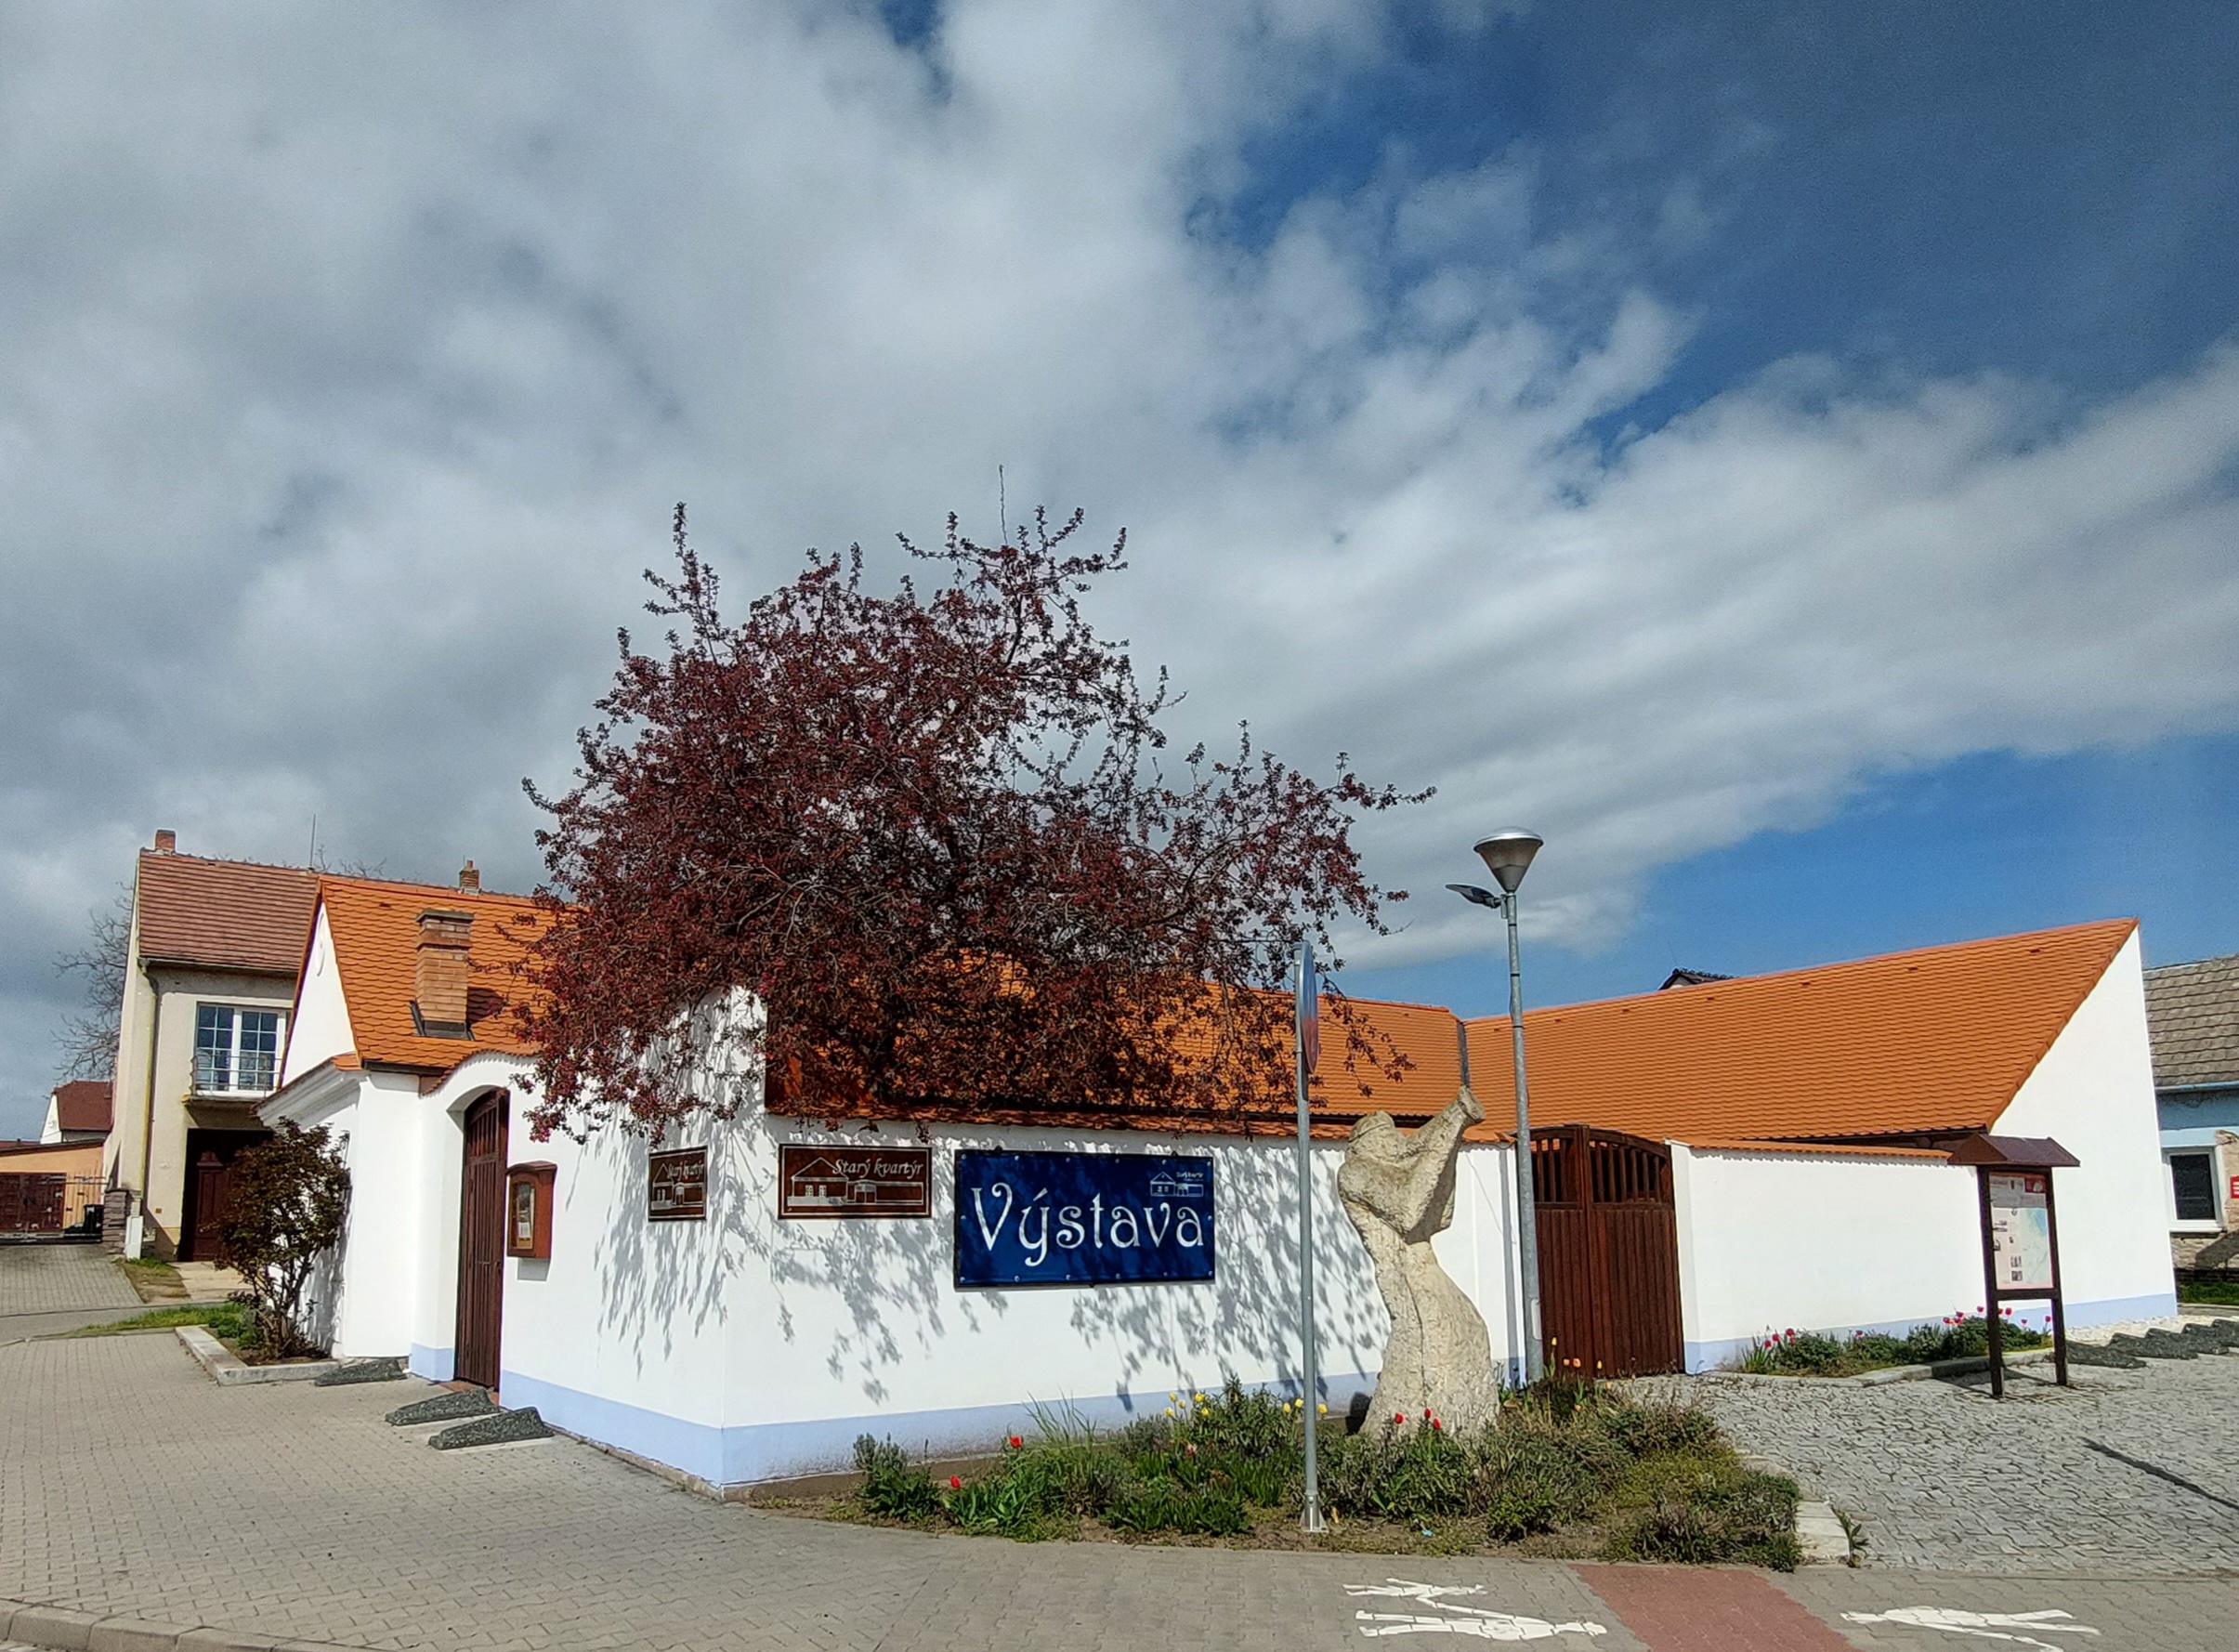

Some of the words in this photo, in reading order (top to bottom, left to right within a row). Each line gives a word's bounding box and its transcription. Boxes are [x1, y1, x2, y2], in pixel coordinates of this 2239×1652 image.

[831, 1159, 871, 1178] Starý
[873, 1158, 923, 1179] kvartýr
[972, 1182, 1204, 1266] Výstava
